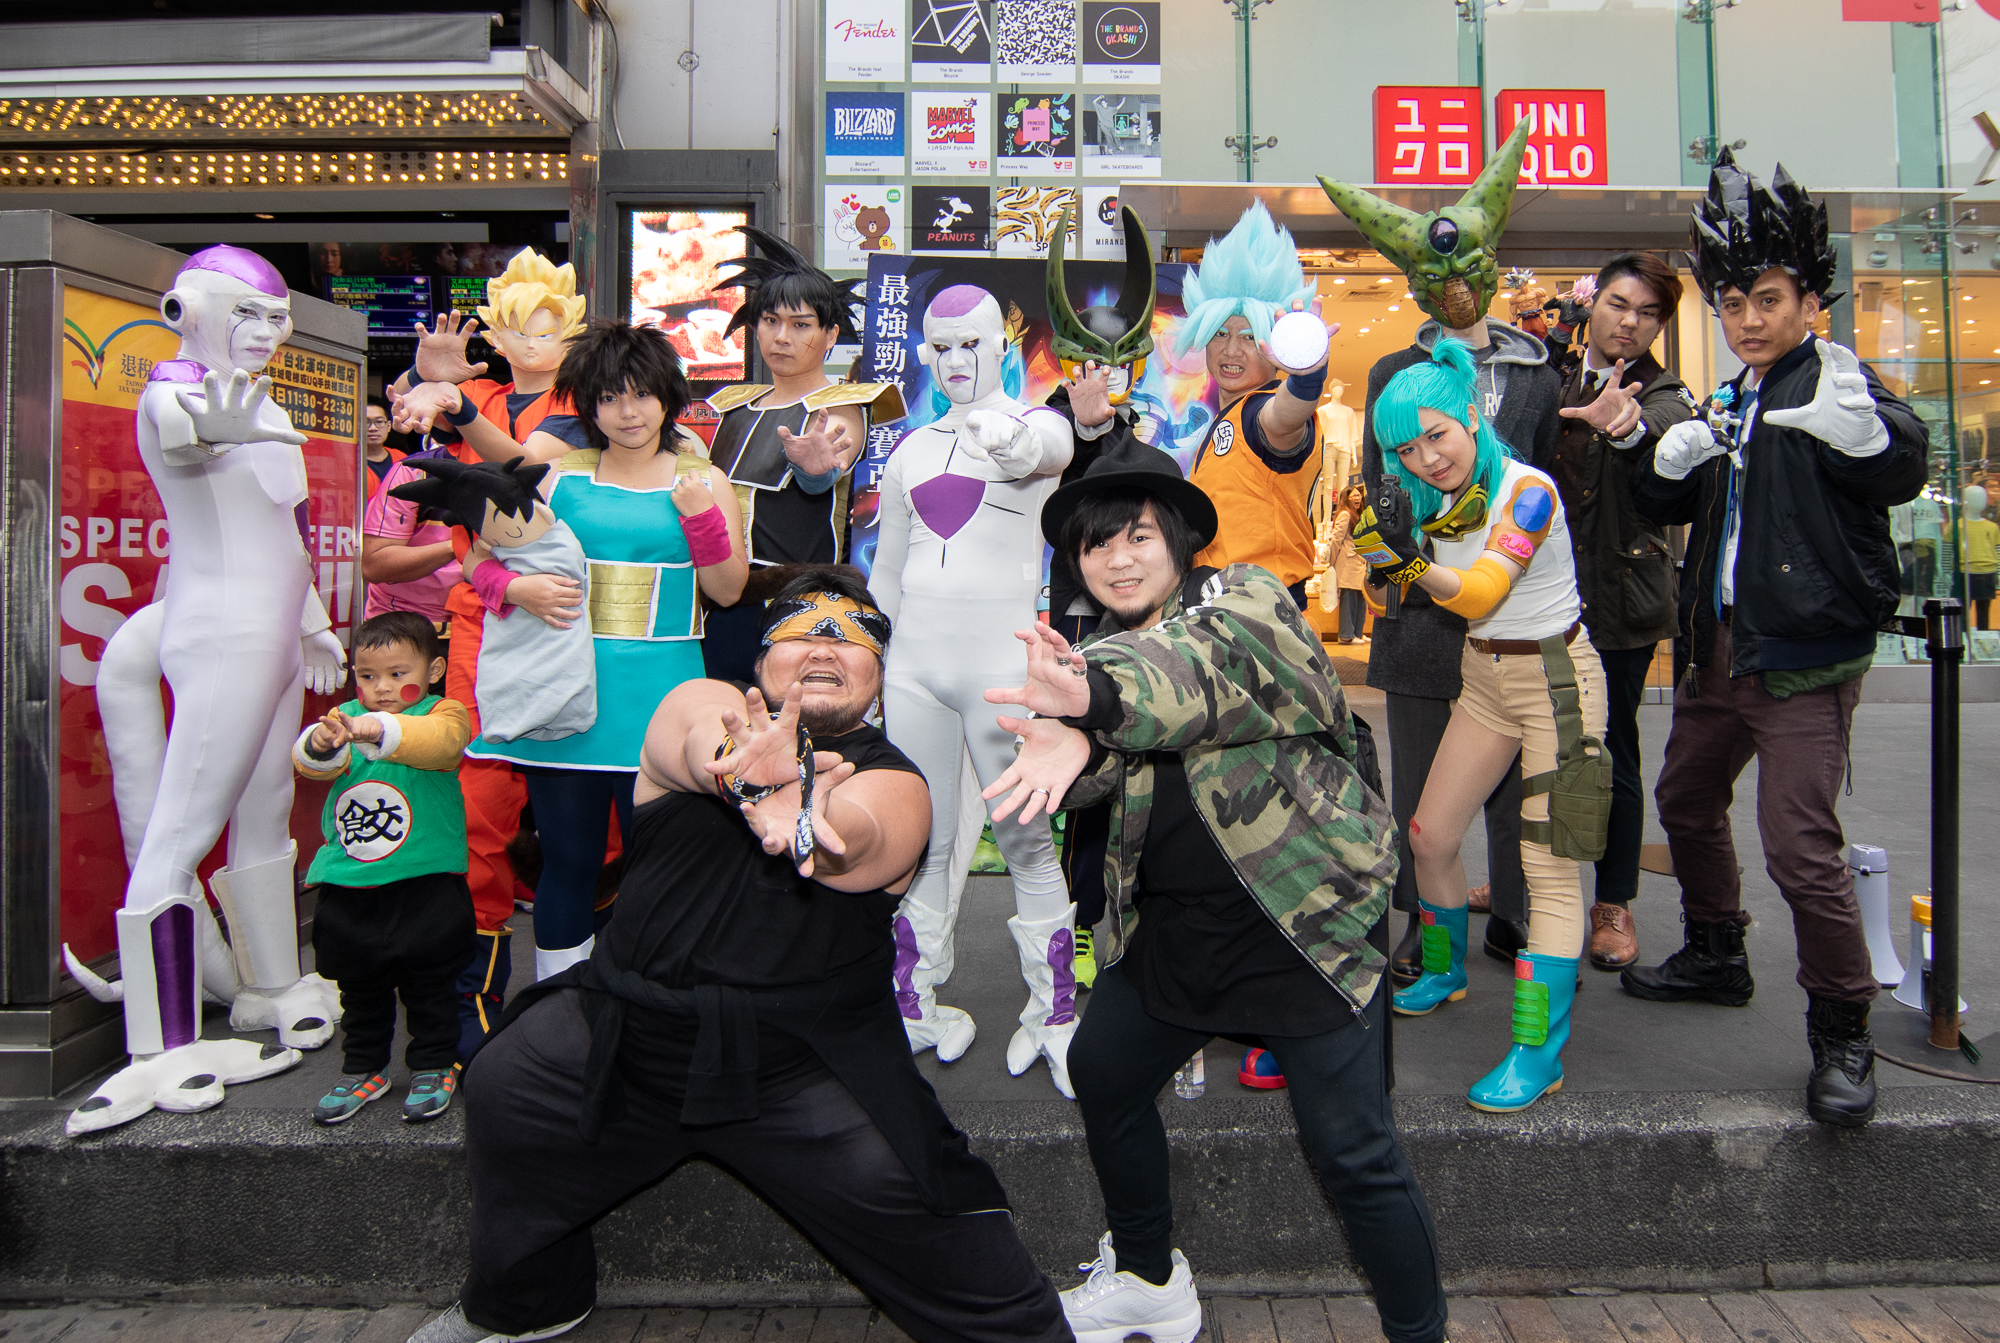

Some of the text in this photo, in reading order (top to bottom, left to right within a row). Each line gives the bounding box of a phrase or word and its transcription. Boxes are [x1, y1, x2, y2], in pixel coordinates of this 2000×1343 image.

[834, 19, 896, 42] Fender
[958, 16, 980, 40] BRANDS
[1100, 24, 1144, 34] THE BRANDS
[1106, 34, 1137, 46] OKASHI
[834, 108, 896, 136] BLIZZARD
[928, 107, 974, 122] MARVEL
[1514, 102, 1585, 137] UNI
[1517, 144, 1594, 184] QLO
[1103, 202, 1107, 210] I
[927, 233, 975, 242] PEANUTS
[120, 354, 153, 378] 退稅
[338, 798, 404, 846] 餃
